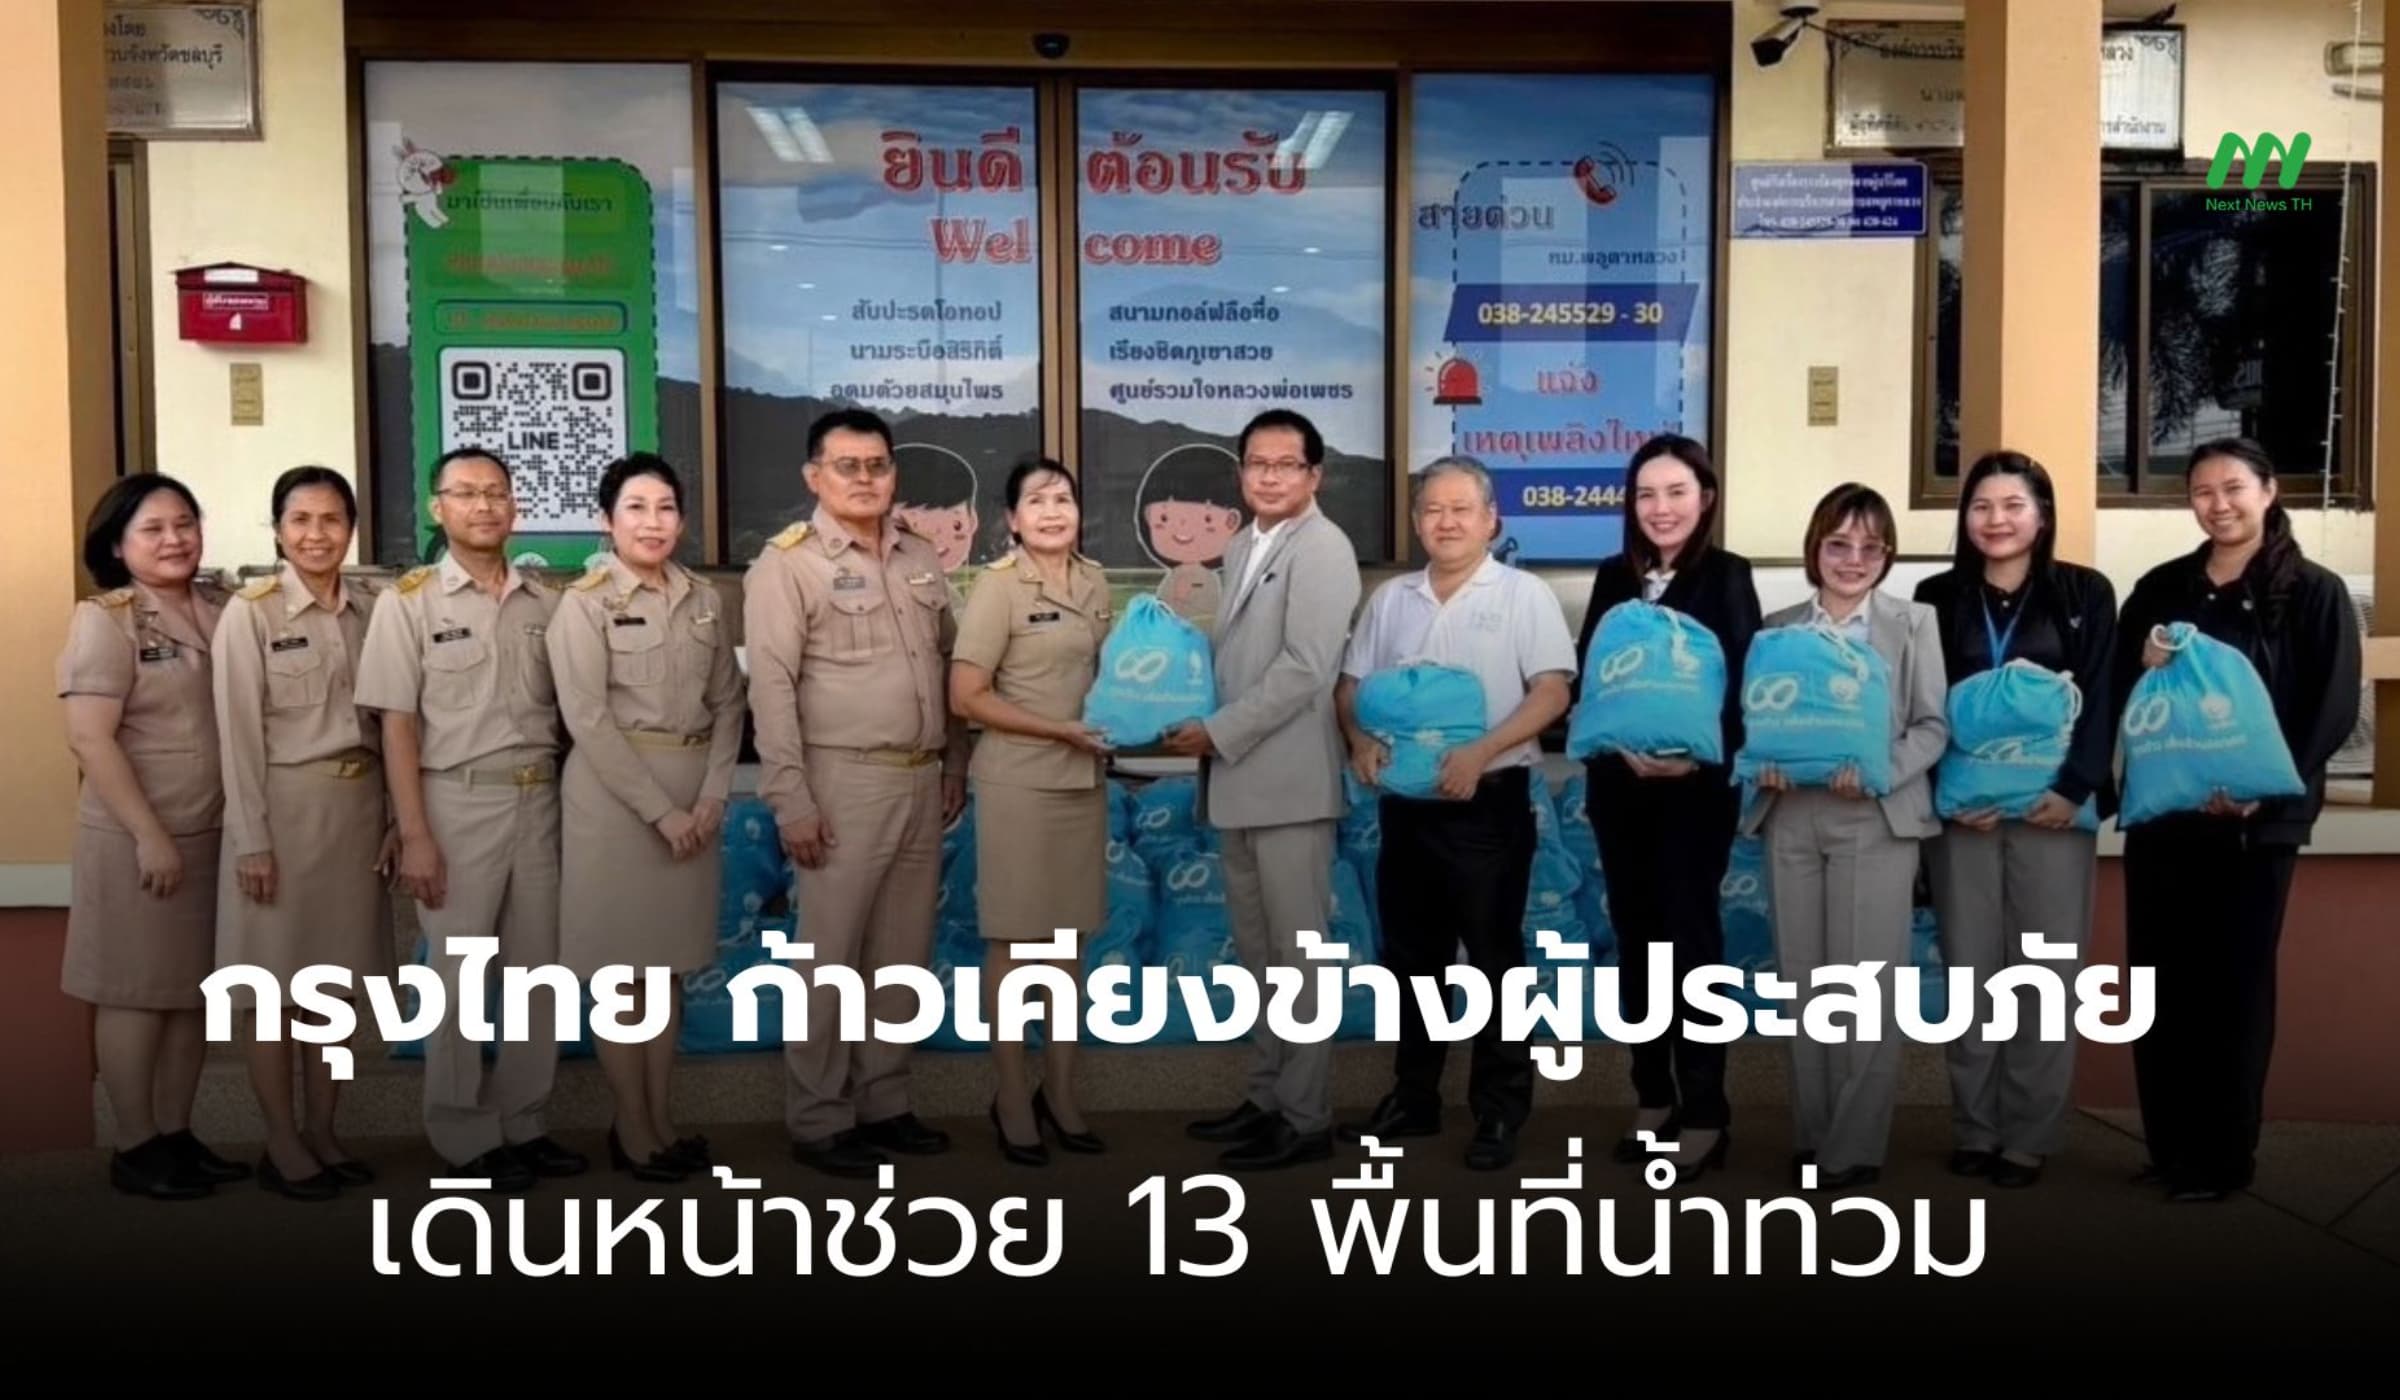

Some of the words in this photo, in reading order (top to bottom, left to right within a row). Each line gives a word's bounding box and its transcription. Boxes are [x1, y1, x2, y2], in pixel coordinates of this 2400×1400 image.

[880, 127, 1024, 192] ยินดี
[1085, 130, 1308, 195] ต้อนรับ
[1418, 195, 1555, 231] สายด่วน
[1083, 231, 1222, 265] come
[1477, 302, 1616, 325] 038-245529
[1633, 302, 1664, 325] 30
[1537, 360, 1600, 395] แจ้ง
[507, 431, 560, 451] LINE
